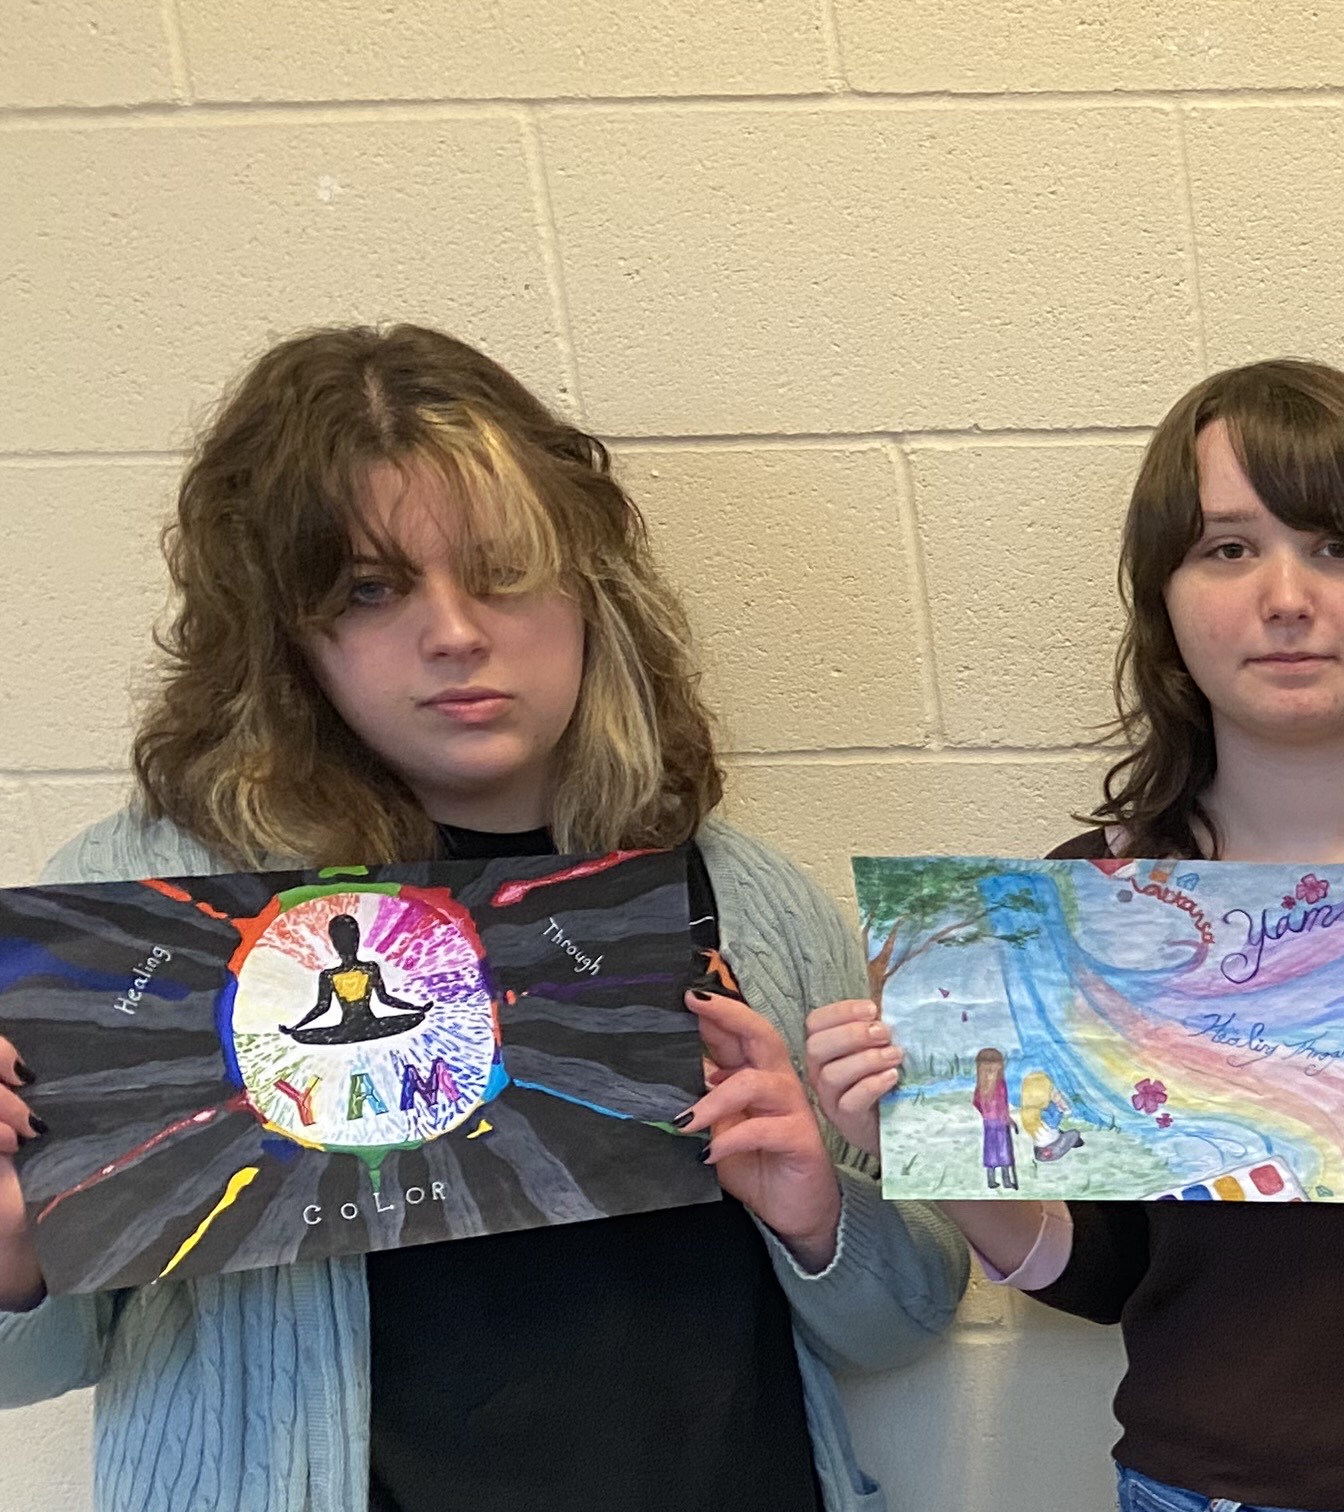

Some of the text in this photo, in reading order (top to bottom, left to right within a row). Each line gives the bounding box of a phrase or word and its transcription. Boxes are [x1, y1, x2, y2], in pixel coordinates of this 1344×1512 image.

[543, 917, 604, 976] Through
[113, 945, 172, 1015] Healing
[273, 1056, 462, 1126] YAM
[303, 1181, 446, 1225] COLOR
